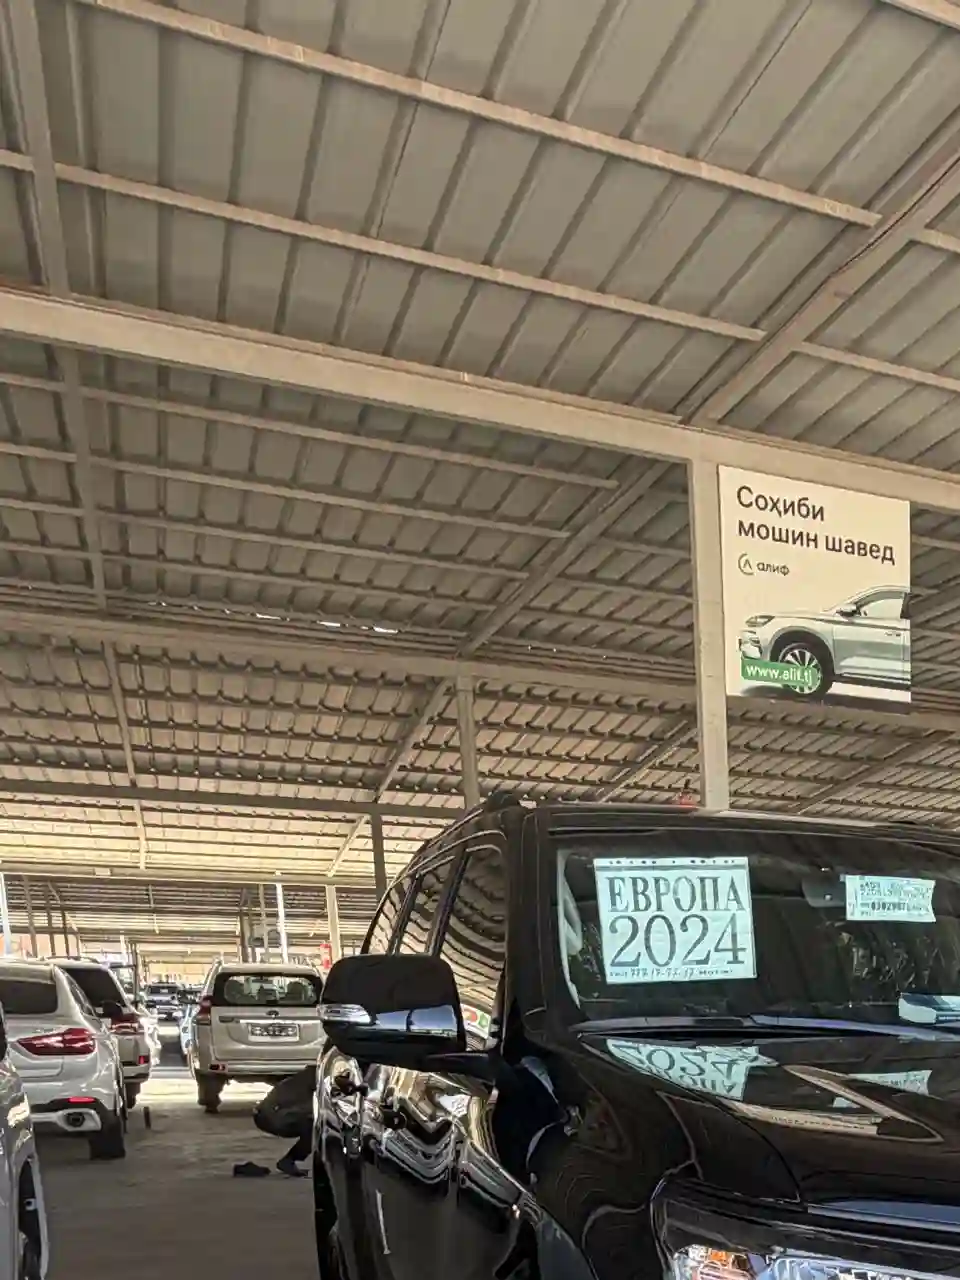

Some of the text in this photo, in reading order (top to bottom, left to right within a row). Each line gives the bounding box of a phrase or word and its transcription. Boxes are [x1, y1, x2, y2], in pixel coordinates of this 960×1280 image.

[738, 520, 896, 566] мошин шавед
[756, 562, 790, 576] алиф
[607, 876, 746, 913] ЕВРОПА
[608, 913, 748, 968] 2024
